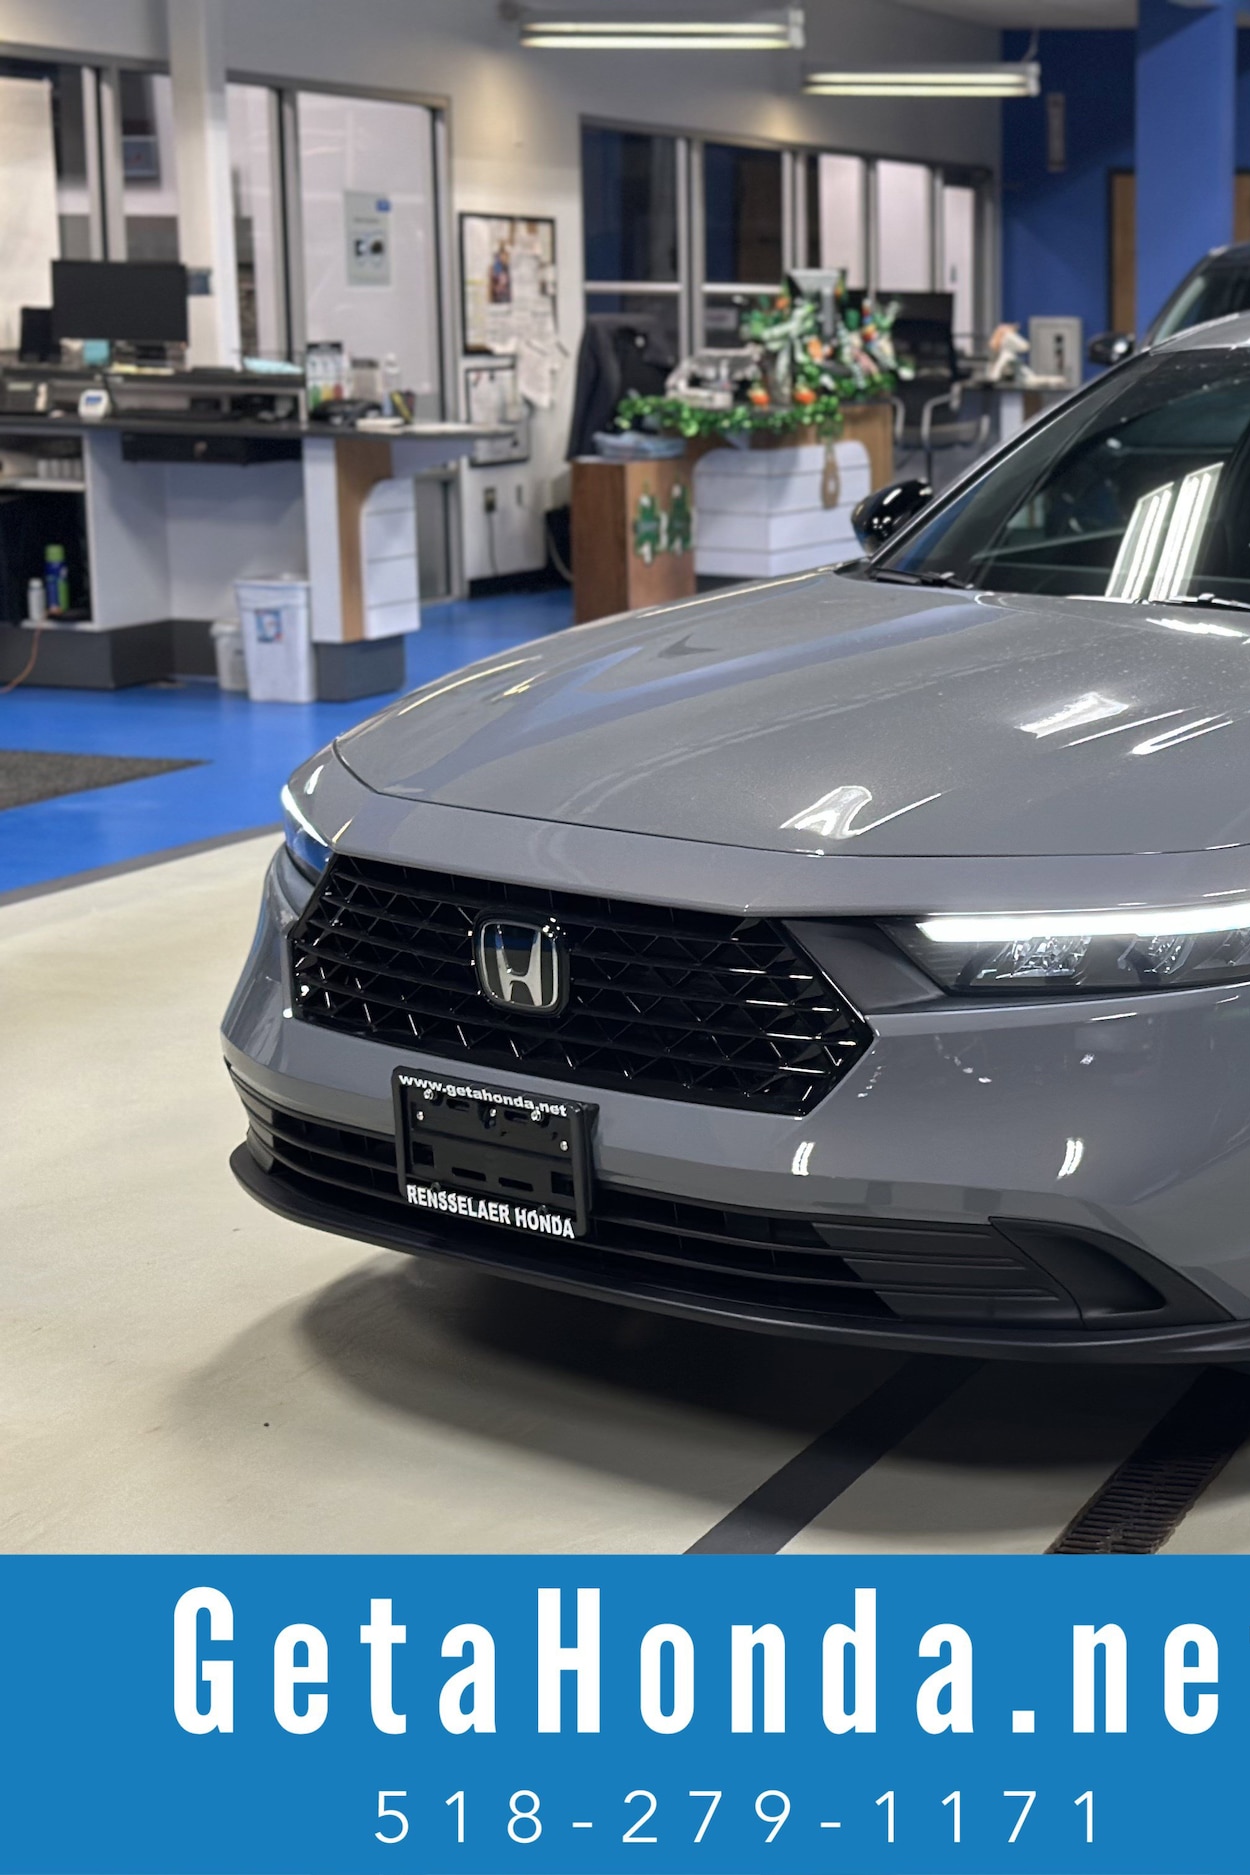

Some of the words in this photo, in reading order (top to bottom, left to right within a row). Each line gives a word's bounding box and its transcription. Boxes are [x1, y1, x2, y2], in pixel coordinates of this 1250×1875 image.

[398, 1074, 568, 1117] www.getahonda.net
[406, 1184, 511, 1225] RENSSELAER
[514, 1206, 576, 1239] HONDA
